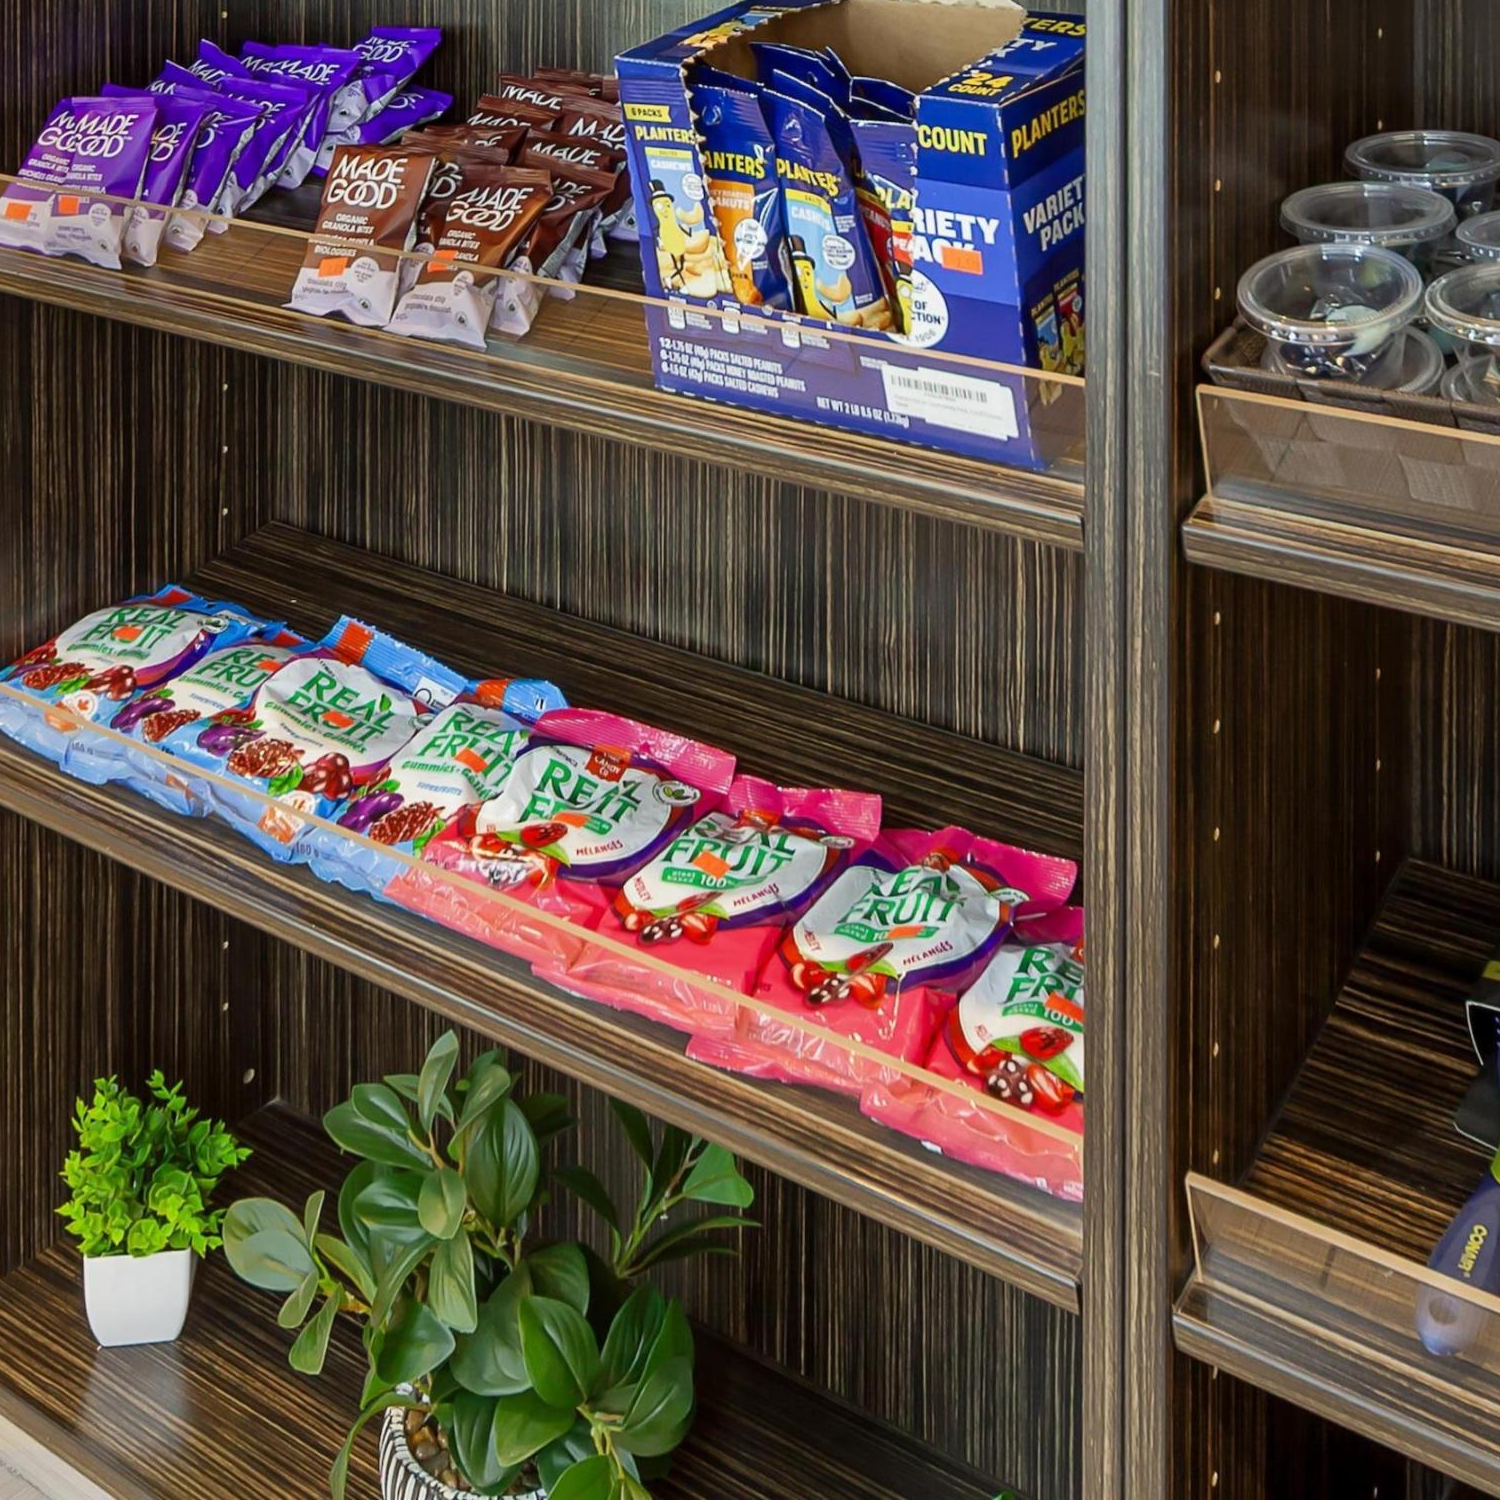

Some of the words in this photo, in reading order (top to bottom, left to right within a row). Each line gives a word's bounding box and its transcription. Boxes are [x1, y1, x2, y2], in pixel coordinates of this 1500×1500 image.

[947, 84, 1003, 98] COUNT
[75, 113, 140, 135] MADE
[638, 108, 663, 118] PACKS
[1011, 90, 1085, 159] PLANTERS
[72, 134, 125, 158] GOOD
[635, 125, 697, 146] PLANTERS
[917, 123, 988, 157] COUNT
[332, 154, 408, 185] MADE
[775, 158, 840, 197] PLANTERS
[326, 179, 399, 210] GOOD
[456, 187, 533, 211] MADE
[321, 220, 354, 234] GRANOLA
[355, 223, 375, 236] BITES
[335, 212, 368, 226] ORGANIC
[447, 200, 516, 233] GOOD
[1040, 203, 1086, 252] PACK
[100, 607, 187, 629] REAL
[300, 669, 397, 735] REAL
[402, 760, 456, 772] gummies
[593, 756, 622, 773] CANDY
[534, 757, 643, 816] REAL
[837, 893, 957, 925] FRUIT
